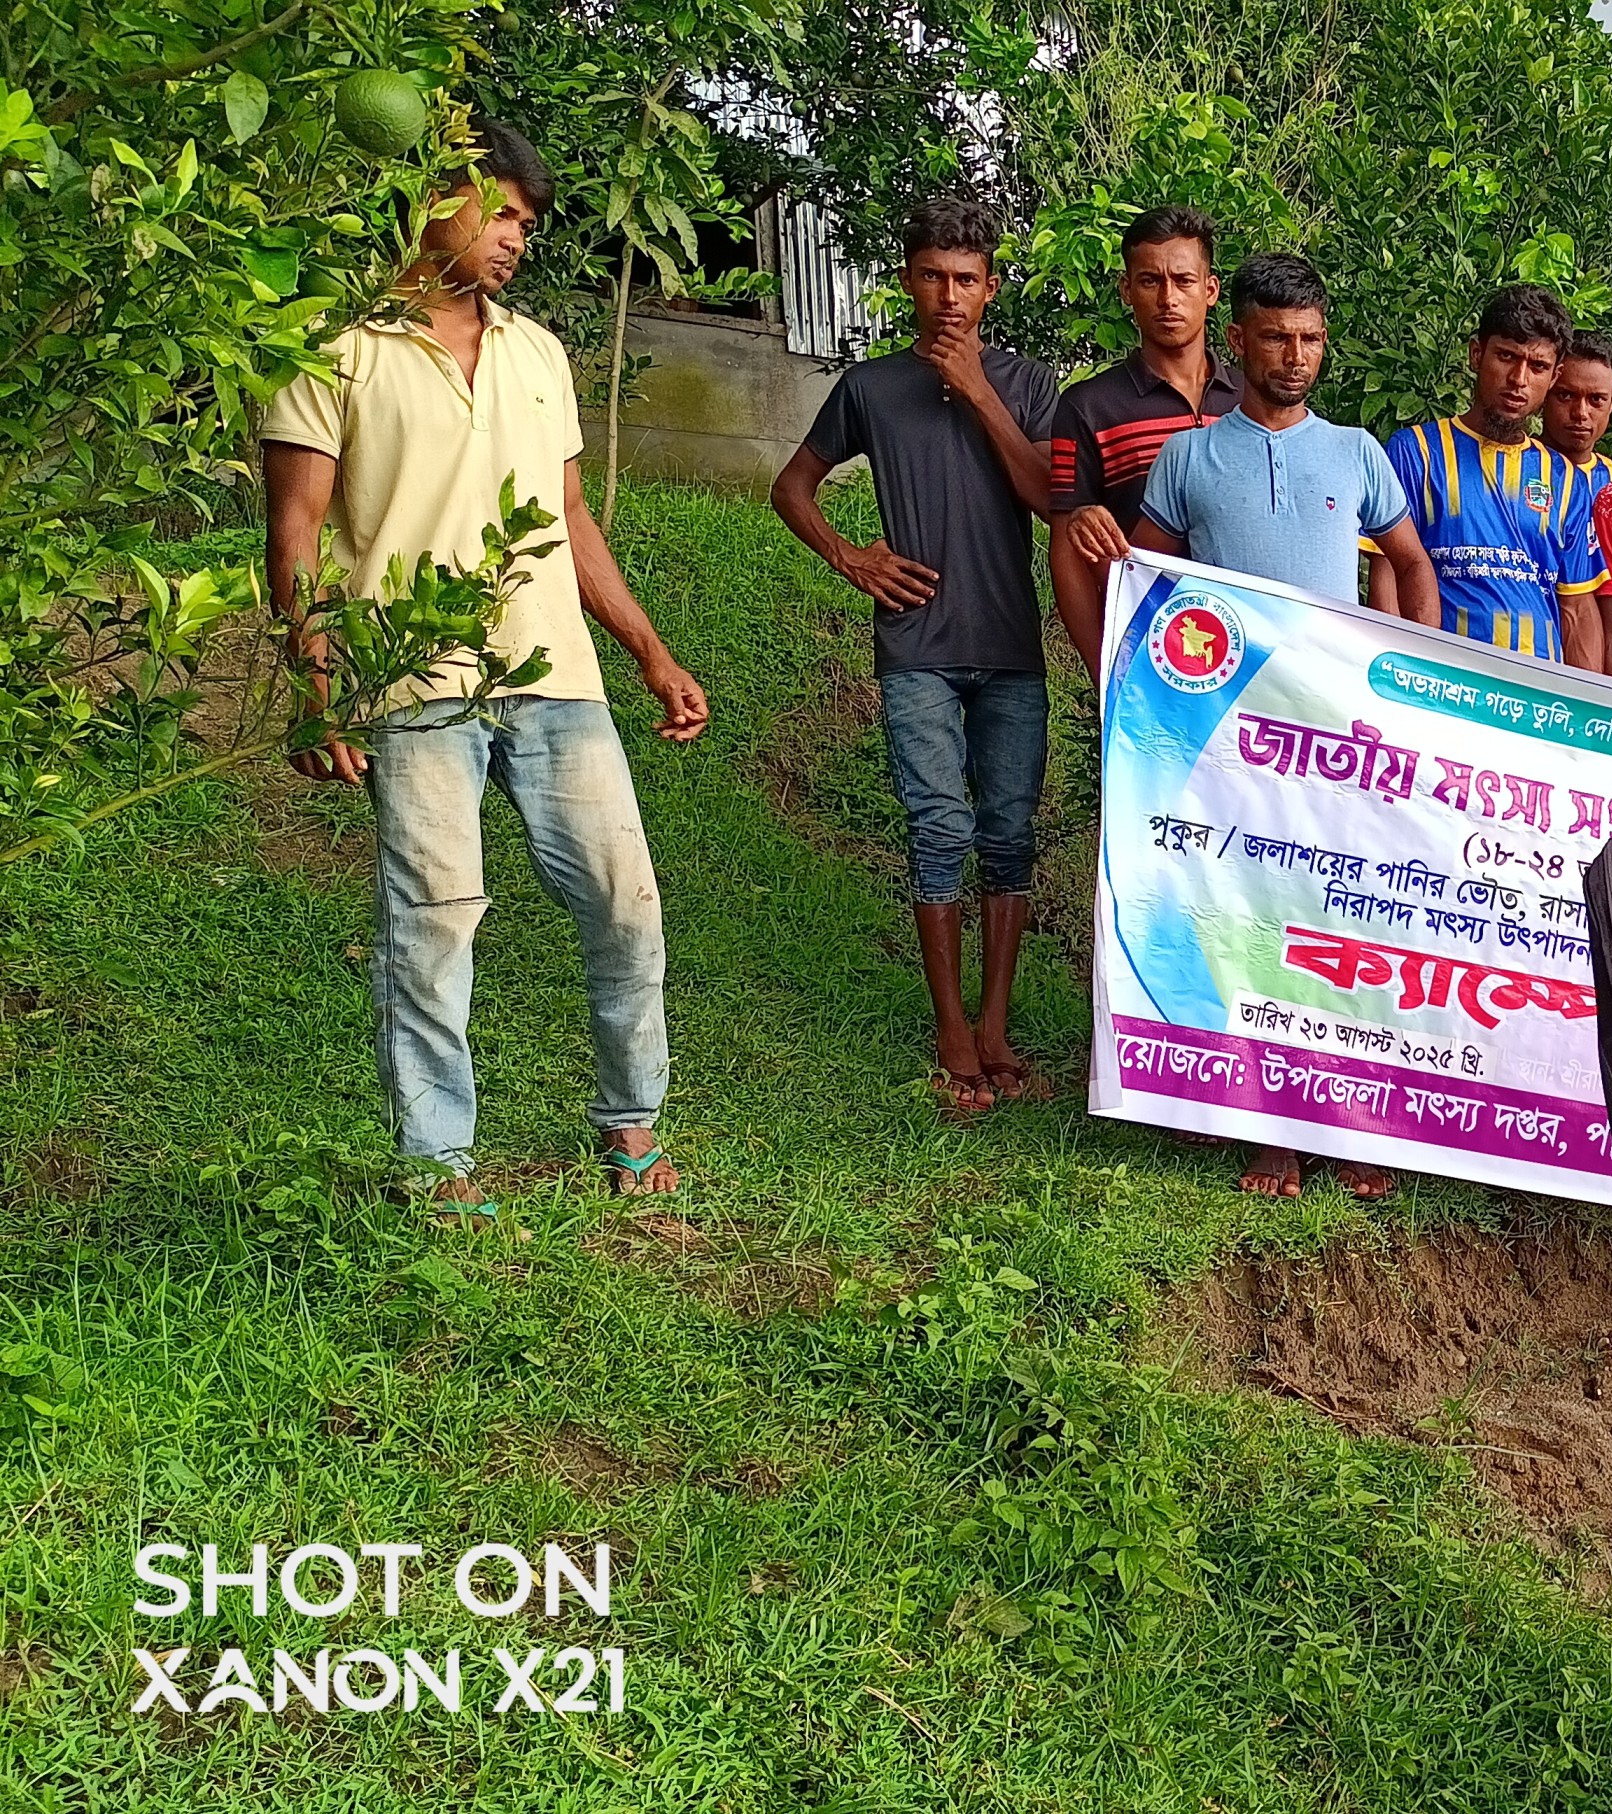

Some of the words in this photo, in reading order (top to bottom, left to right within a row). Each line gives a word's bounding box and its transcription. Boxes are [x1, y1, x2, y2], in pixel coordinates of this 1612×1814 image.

[1162, 664, 1218, 690] সরকার
[1485, 692, 1528, 724] গড়ে
[1533, 702, 1575, 738] তুলি,
[1238, 712, 1420, 805] জাতীয়
[1432, 756, 1555, 834] মৎস্য
[1149, 813, 1215, 856] পুকুর
[1217, 825, 1237, 859] /
[1243, 833, 1368, 883] জলাশয়ের
[1376, 859, 1450, 900] পানির
[1457, 872, 1526, 922] ভৌত,
[1463, 832, 1565, 880] (১৮-২৪
[1323, 878, 1418, 930] নিরাপদ
[1425, 906, 1491, 943] মৎস্য
[1240, 1002, 1295, 1033] তারিখ
[1299, 1018, 1328, 1041] ২৩
[1335, 1023, 1396, 1053] আগস্ট
[1400, 1040, 1454, 1070] ২০২৫
[1115, 1027, 1246, 1089] য়োজনে:
[1260, 1048, 1397, 1118] উপজেলা
[1403, 1085, 1487, 1133] মৎস্য
[1493, 1102, 1568, 1156] দপ্তর,
[1560, 1059, 1601, 1092] শ্রীরা
